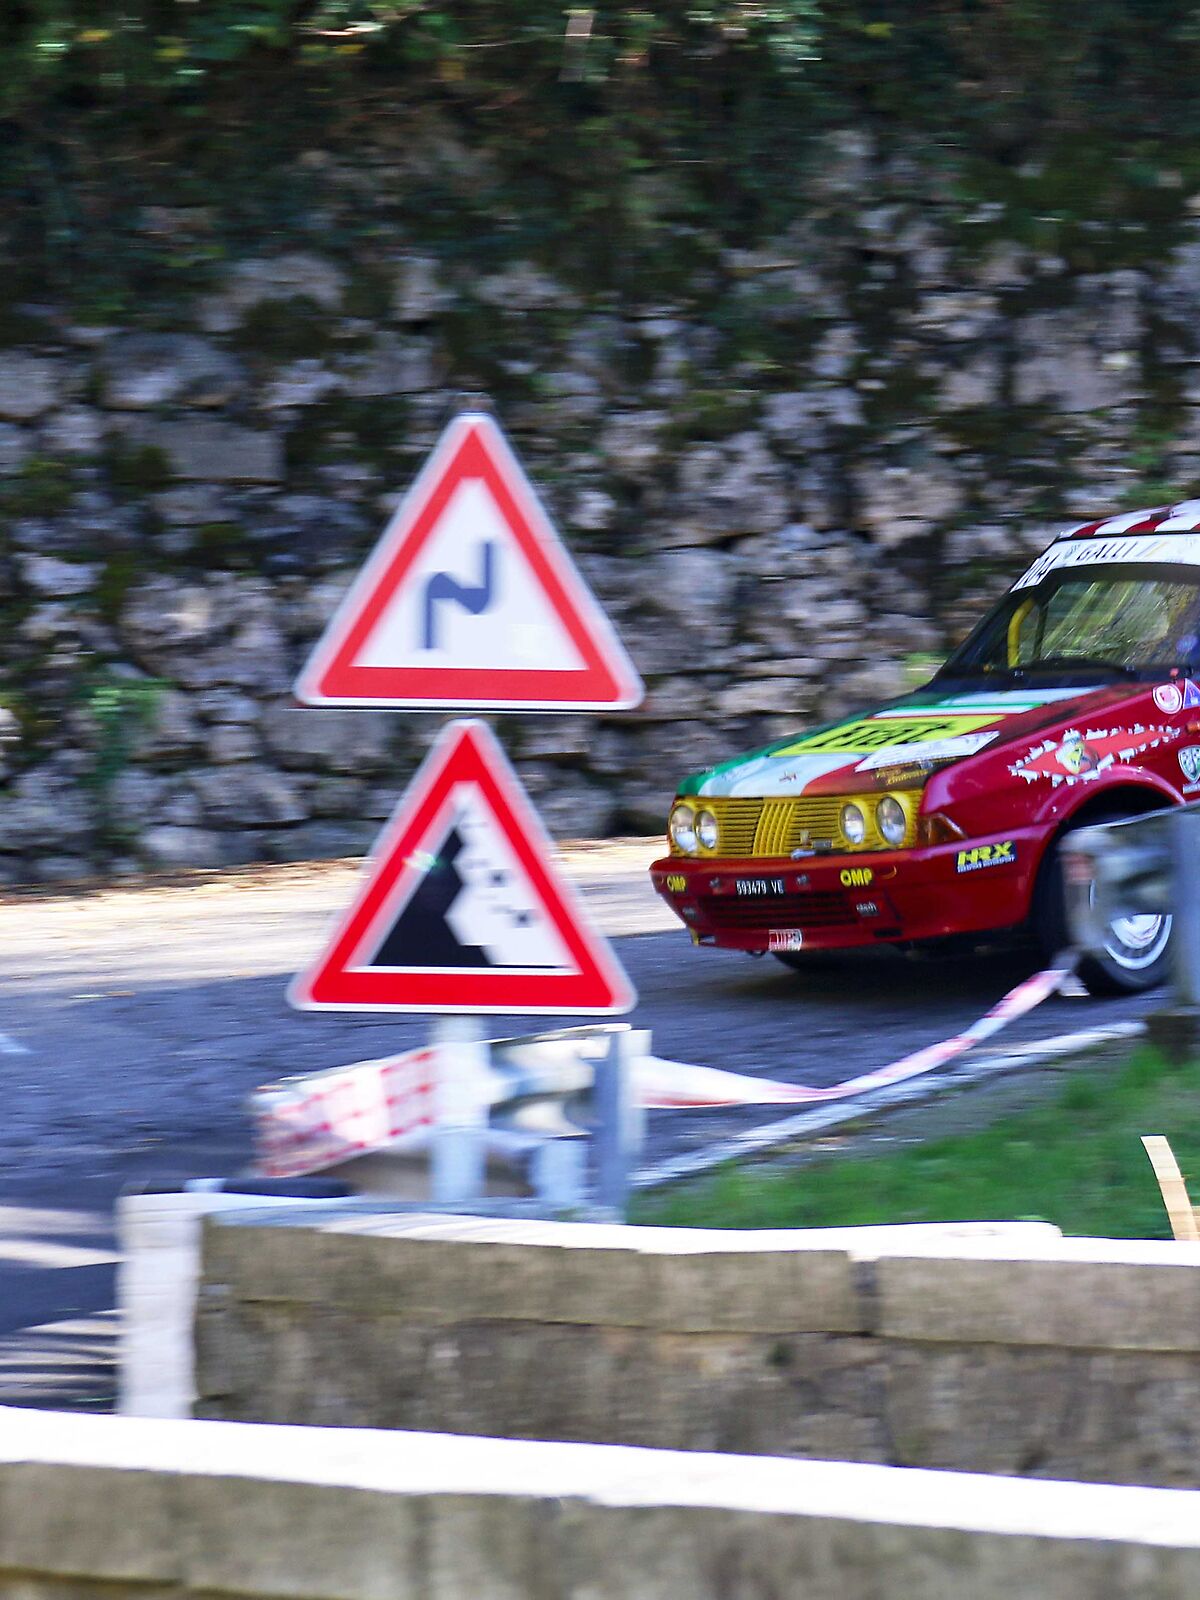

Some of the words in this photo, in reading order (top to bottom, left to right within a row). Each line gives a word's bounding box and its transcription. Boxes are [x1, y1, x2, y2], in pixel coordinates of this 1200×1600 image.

[957, 842, 1012, 867] HRX
[667, 875, 686, 892] OMP
[839, 868, 874, 887] OMP
